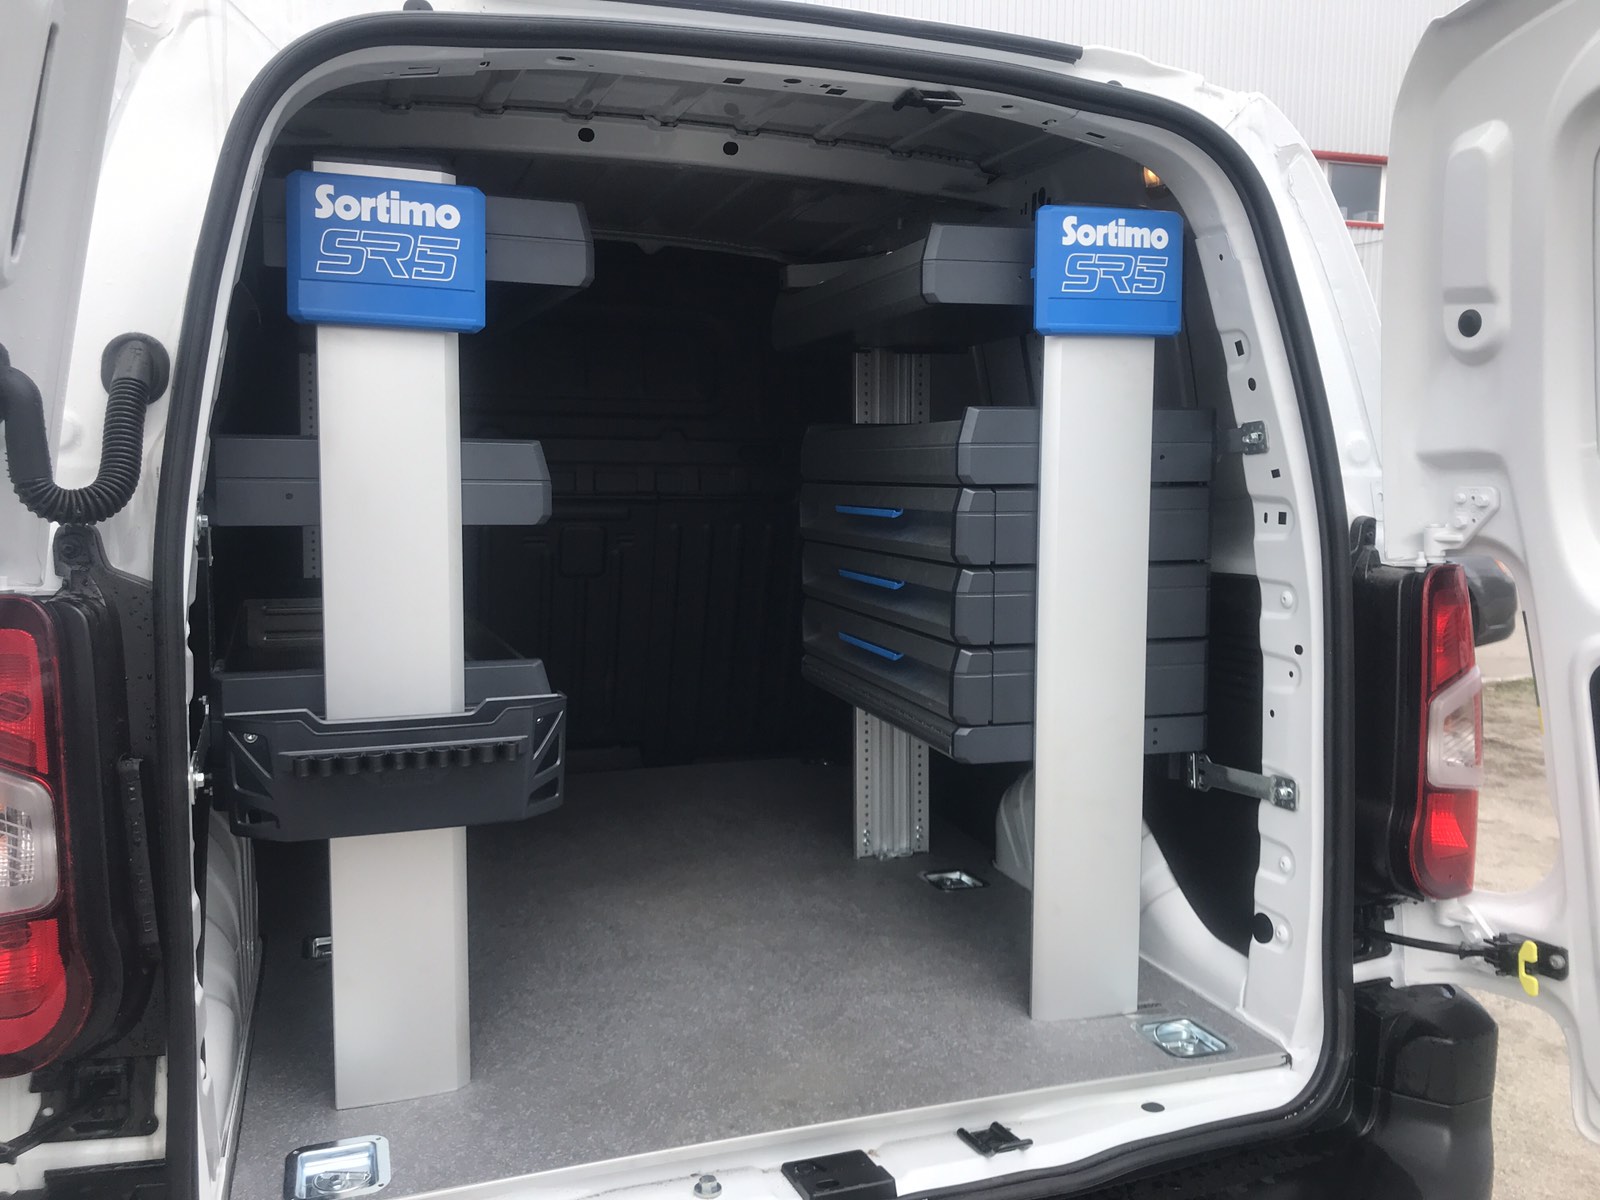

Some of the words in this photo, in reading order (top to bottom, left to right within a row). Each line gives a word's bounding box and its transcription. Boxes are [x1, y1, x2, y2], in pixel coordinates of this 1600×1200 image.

[315, 184, 461, 229] Sortimo
[1062, 216, 1169, 249] Sortimo
[316, 228, 461, 281] SR5
[1061, 253, 1169, 294] SR5
